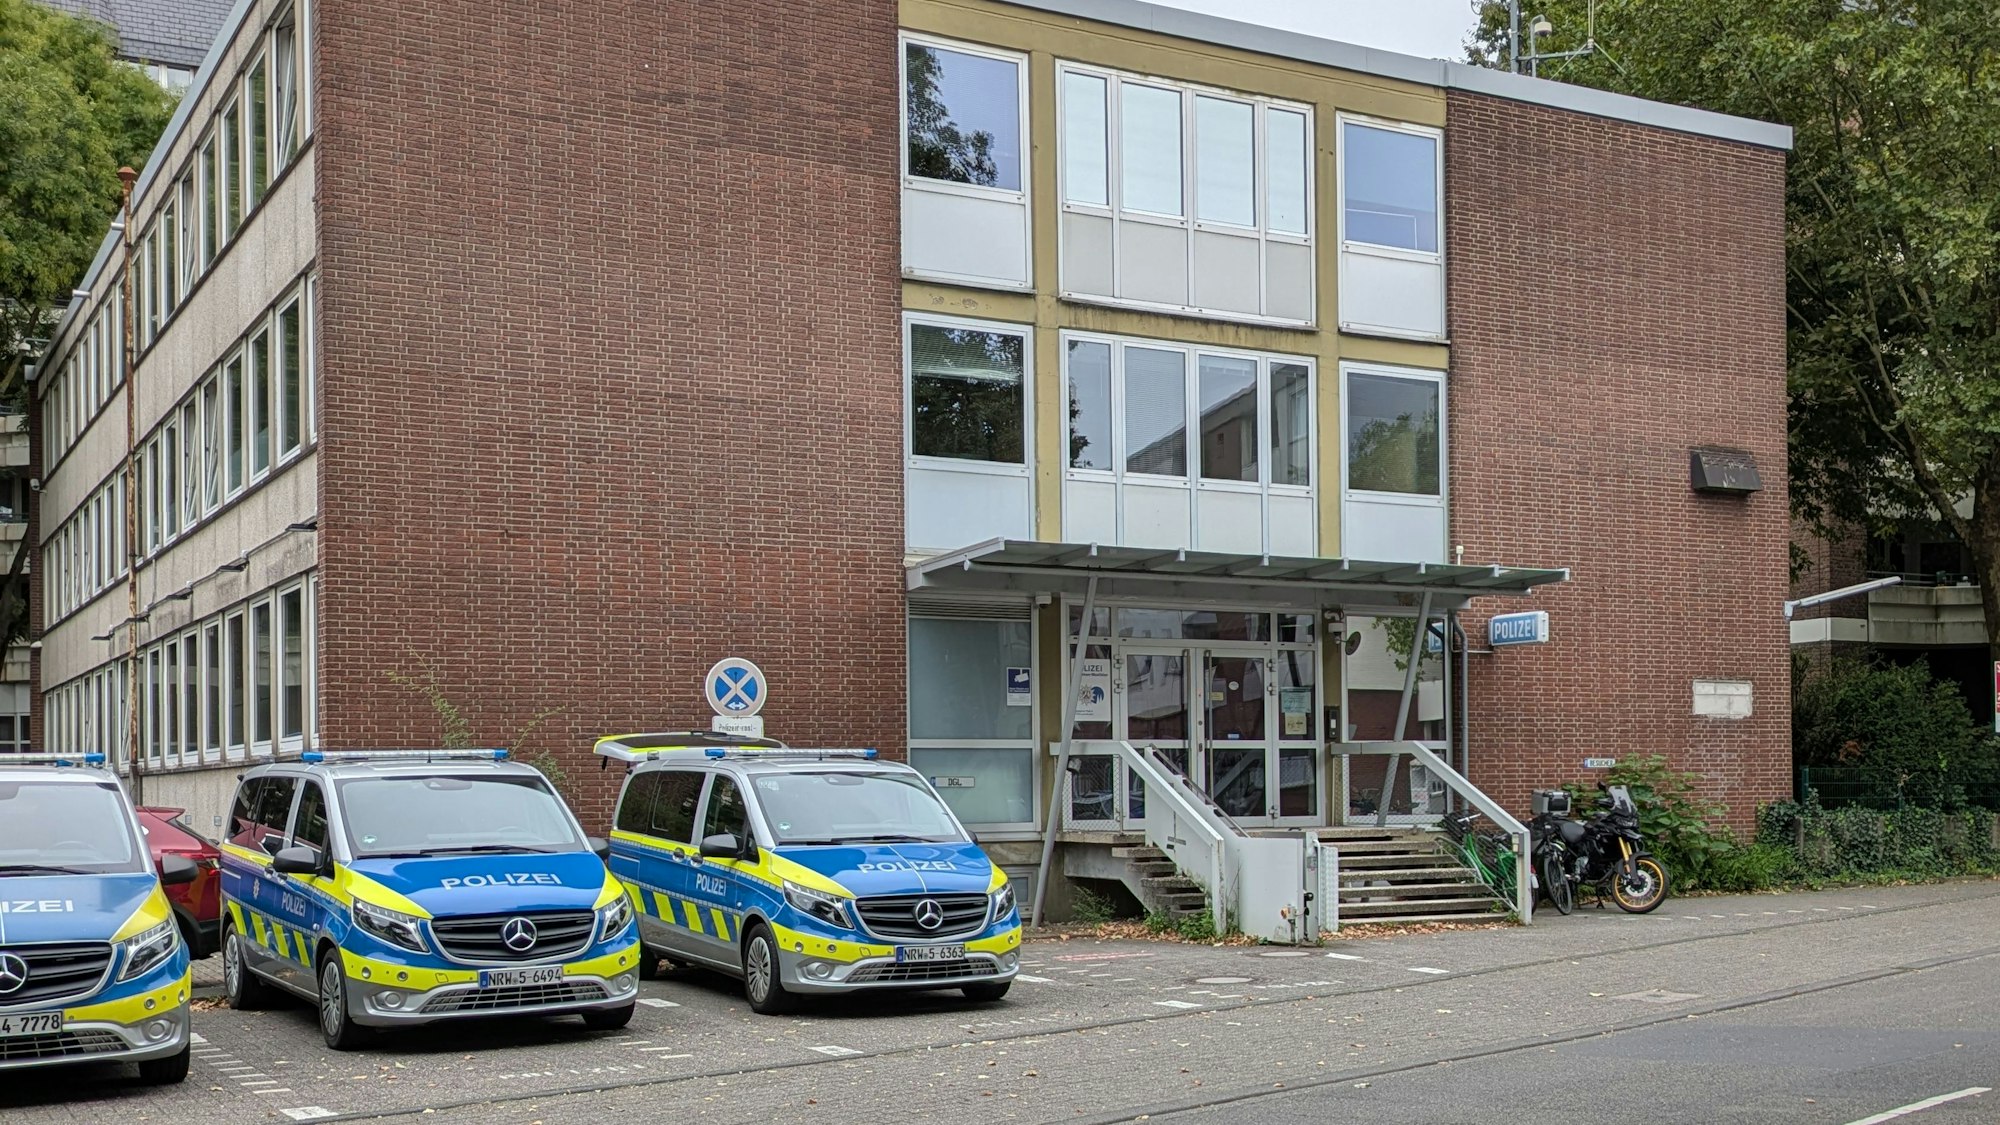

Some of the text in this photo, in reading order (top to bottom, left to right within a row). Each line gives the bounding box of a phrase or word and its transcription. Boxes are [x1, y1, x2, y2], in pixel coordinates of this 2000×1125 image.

[1494, 619, 1537, 640] POLIZEI
[947, 778, 962, 786] DGL
[856, 861, 958, 874] POLIZEI
[440, 873, 562, 890] POLIZEI
[695, 872, 727, 897] POLIZEI
[0, 900, 74, 913] IZEI
[281, 891, 306, 918] POLIZEI
[904, 946, 964, 961] NRW 5-6363
[488, 968, 562, 986] NRW 5-6494
[1, 1014, 60, 1034] 4-7778
